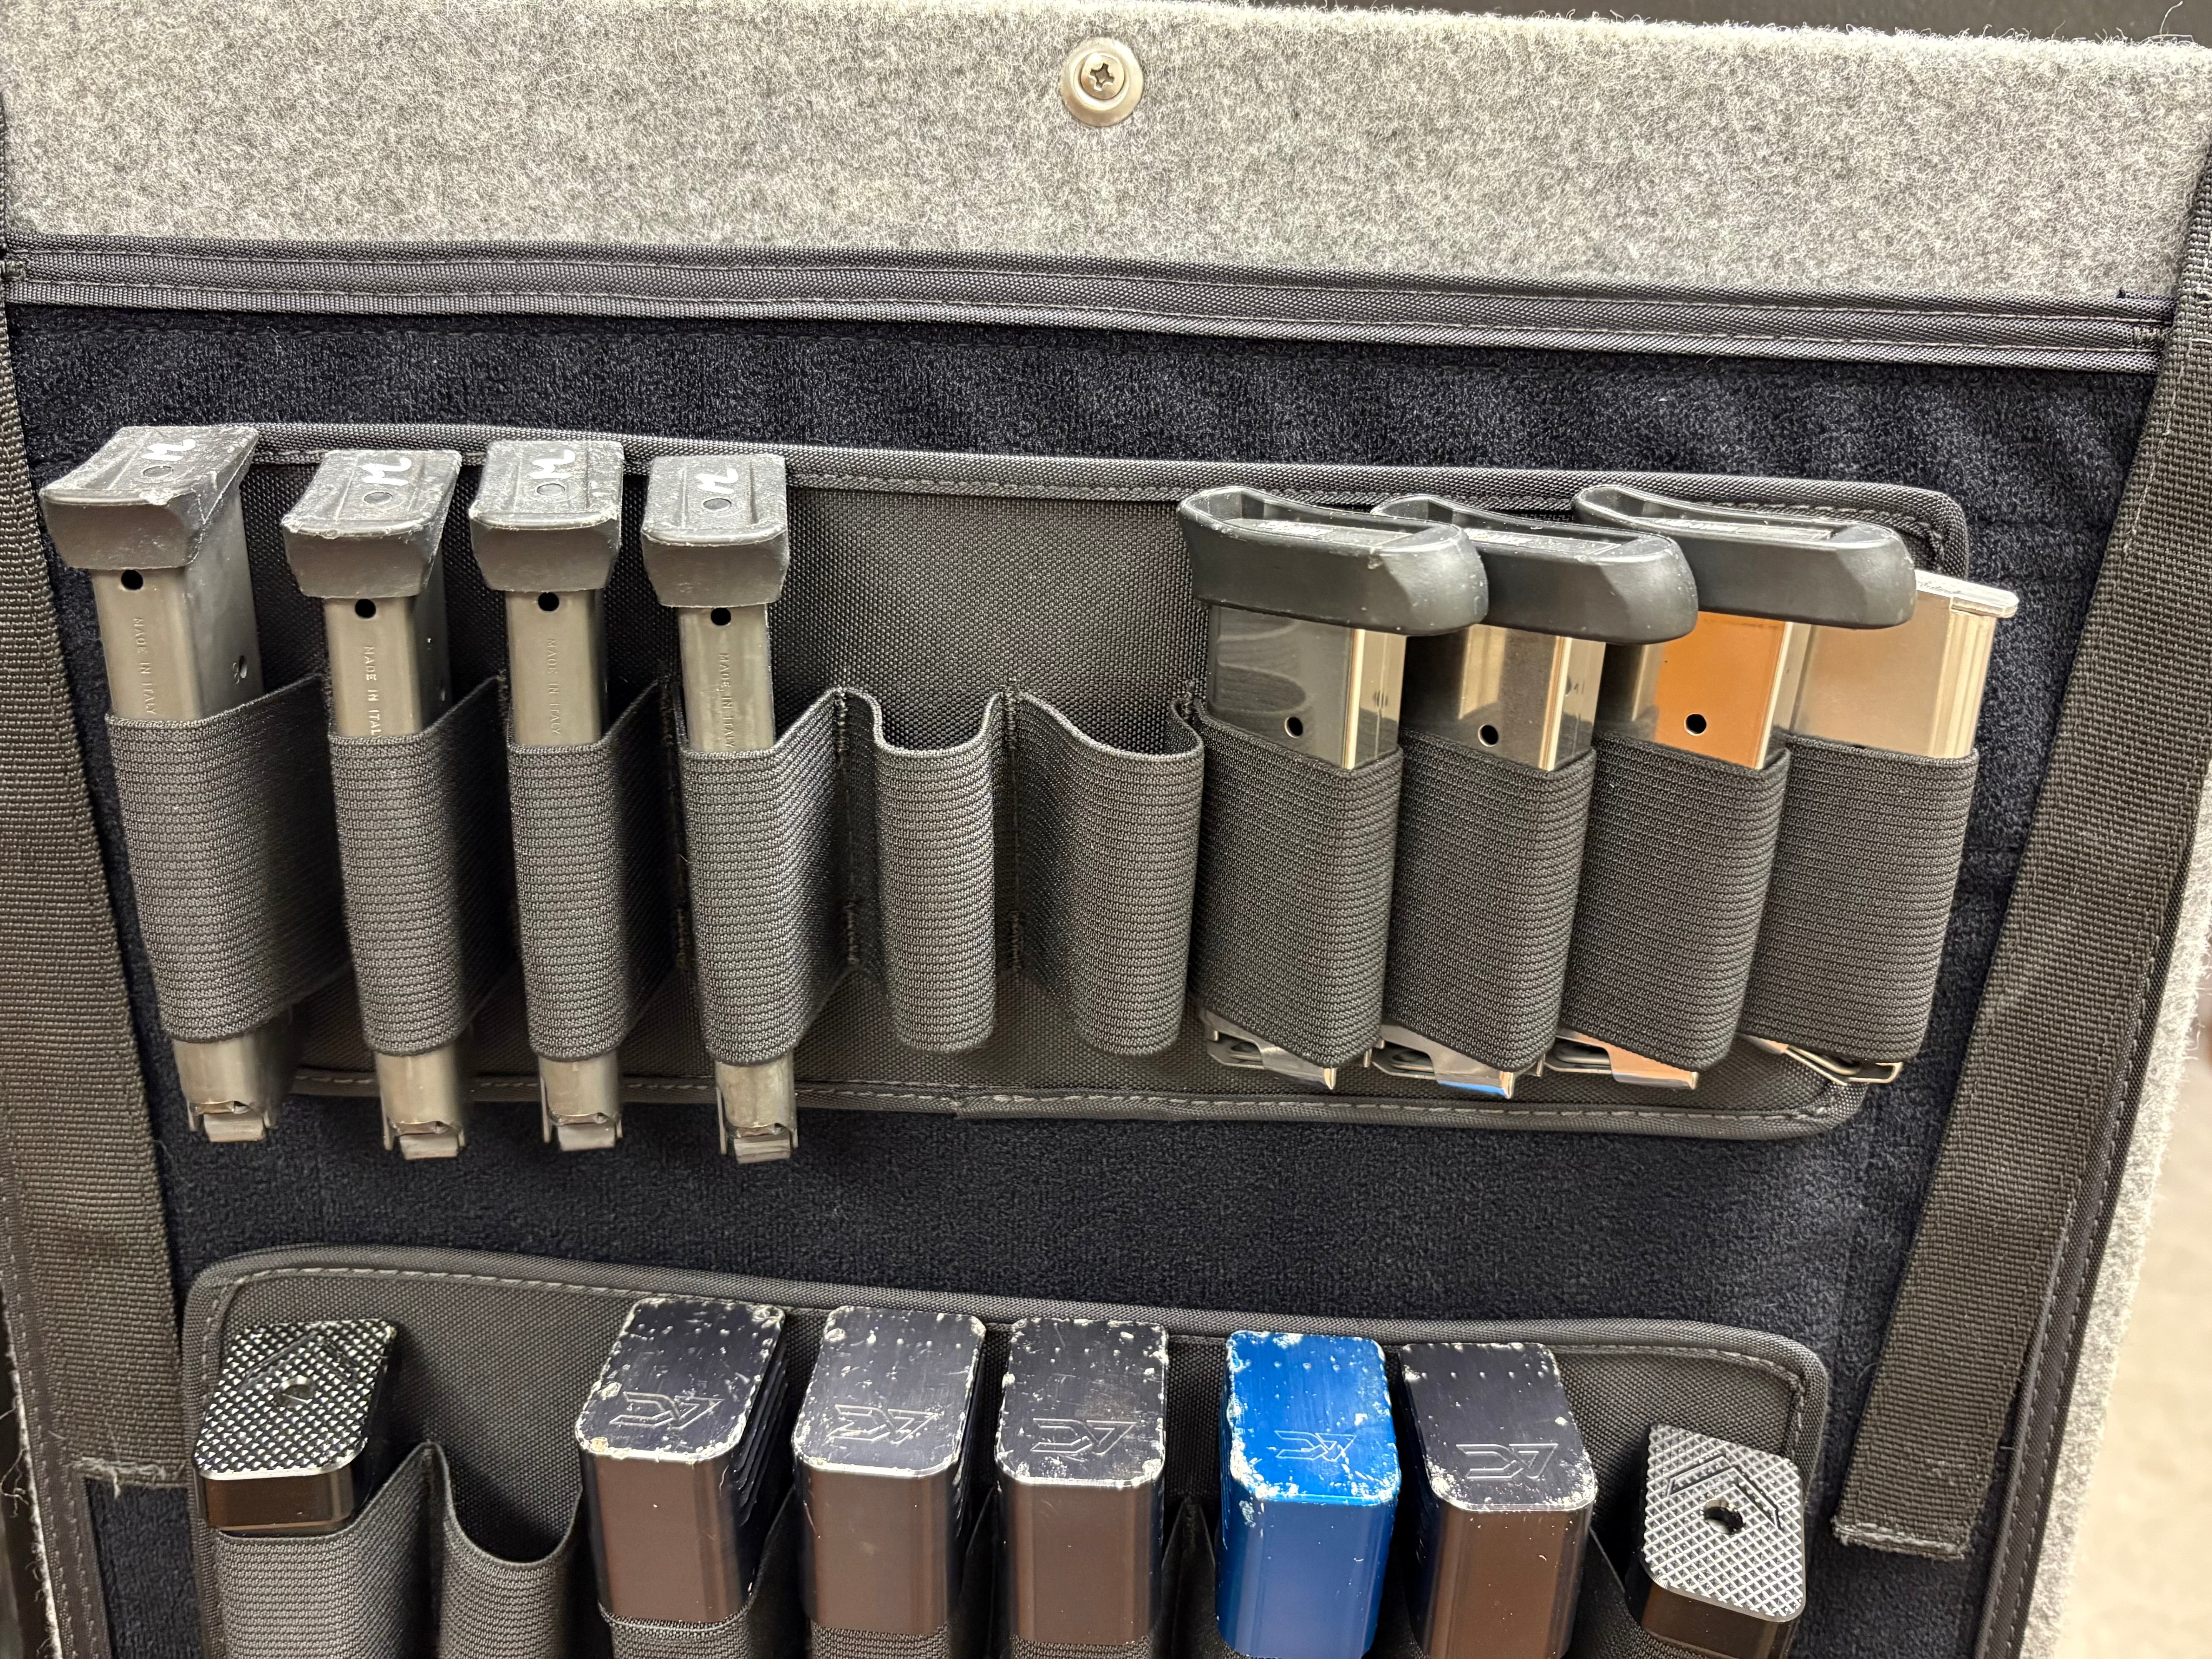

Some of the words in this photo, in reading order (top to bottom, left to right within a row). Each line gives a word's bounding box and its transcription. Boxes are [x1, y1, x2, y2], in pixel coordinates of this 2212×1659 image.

[133, 617, 147, 653] MADE
[139, 662, 151, 674] IN
[363, 646, 377, 680] MADE
[546, 640, 557, 674] MADE
[367, 690, 379, 701] IN
[548, 683, 559, 694] IN
[721, 697, 733, 708] IN
[368, 710, 382, 738] ITAL
[549, 703, 561, 734] ITALY
